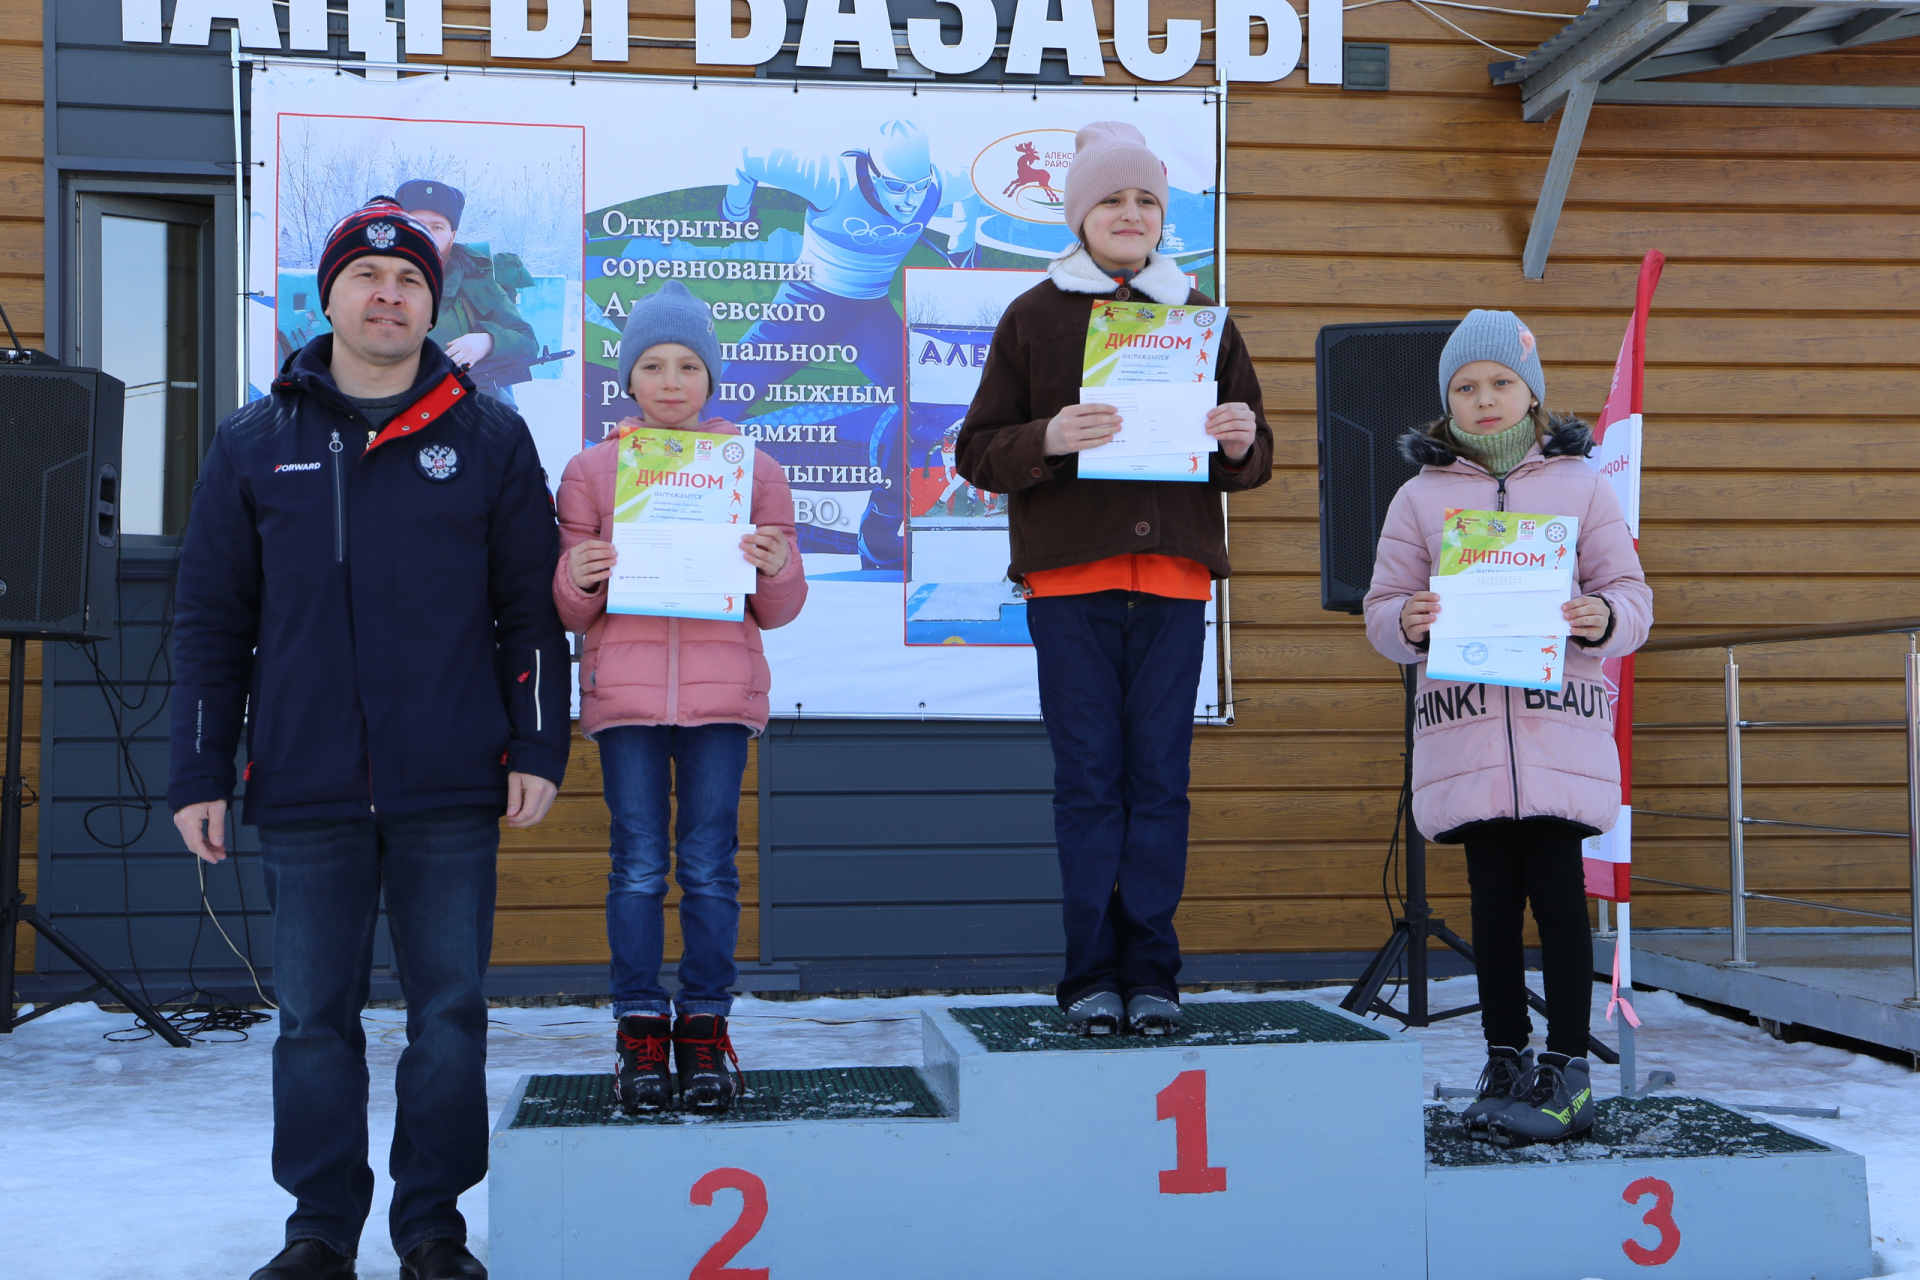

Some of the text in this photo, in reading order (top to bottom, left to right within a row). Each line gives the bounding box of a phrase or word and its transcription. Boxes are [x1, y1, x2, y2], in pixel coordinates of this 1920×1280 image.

[1045, 151, 1077, 160] АЛЕКСЕ
[1045, 160, 1072, 168] РАЙО
[602, 210, 759, 244] Открытые
[602, 257, 812, 284] соревнования
[1104, 332, 1193, 350] ДИПЛОМ
[918, 340, 987, 368] АЛЕ
[719, 383, 895, 404] по лыжным
[274, 462, 321, 473] FORWARD
[635, 469, 724, 490] ДИПЛОМ
[1458, 548, 1546, 567] ДИПЛОМ
[1156, 1070, 1226, 1194] 1
[688, 1167, 769, 1280] 2
[1622, 1176, 1682, 1265] 3
